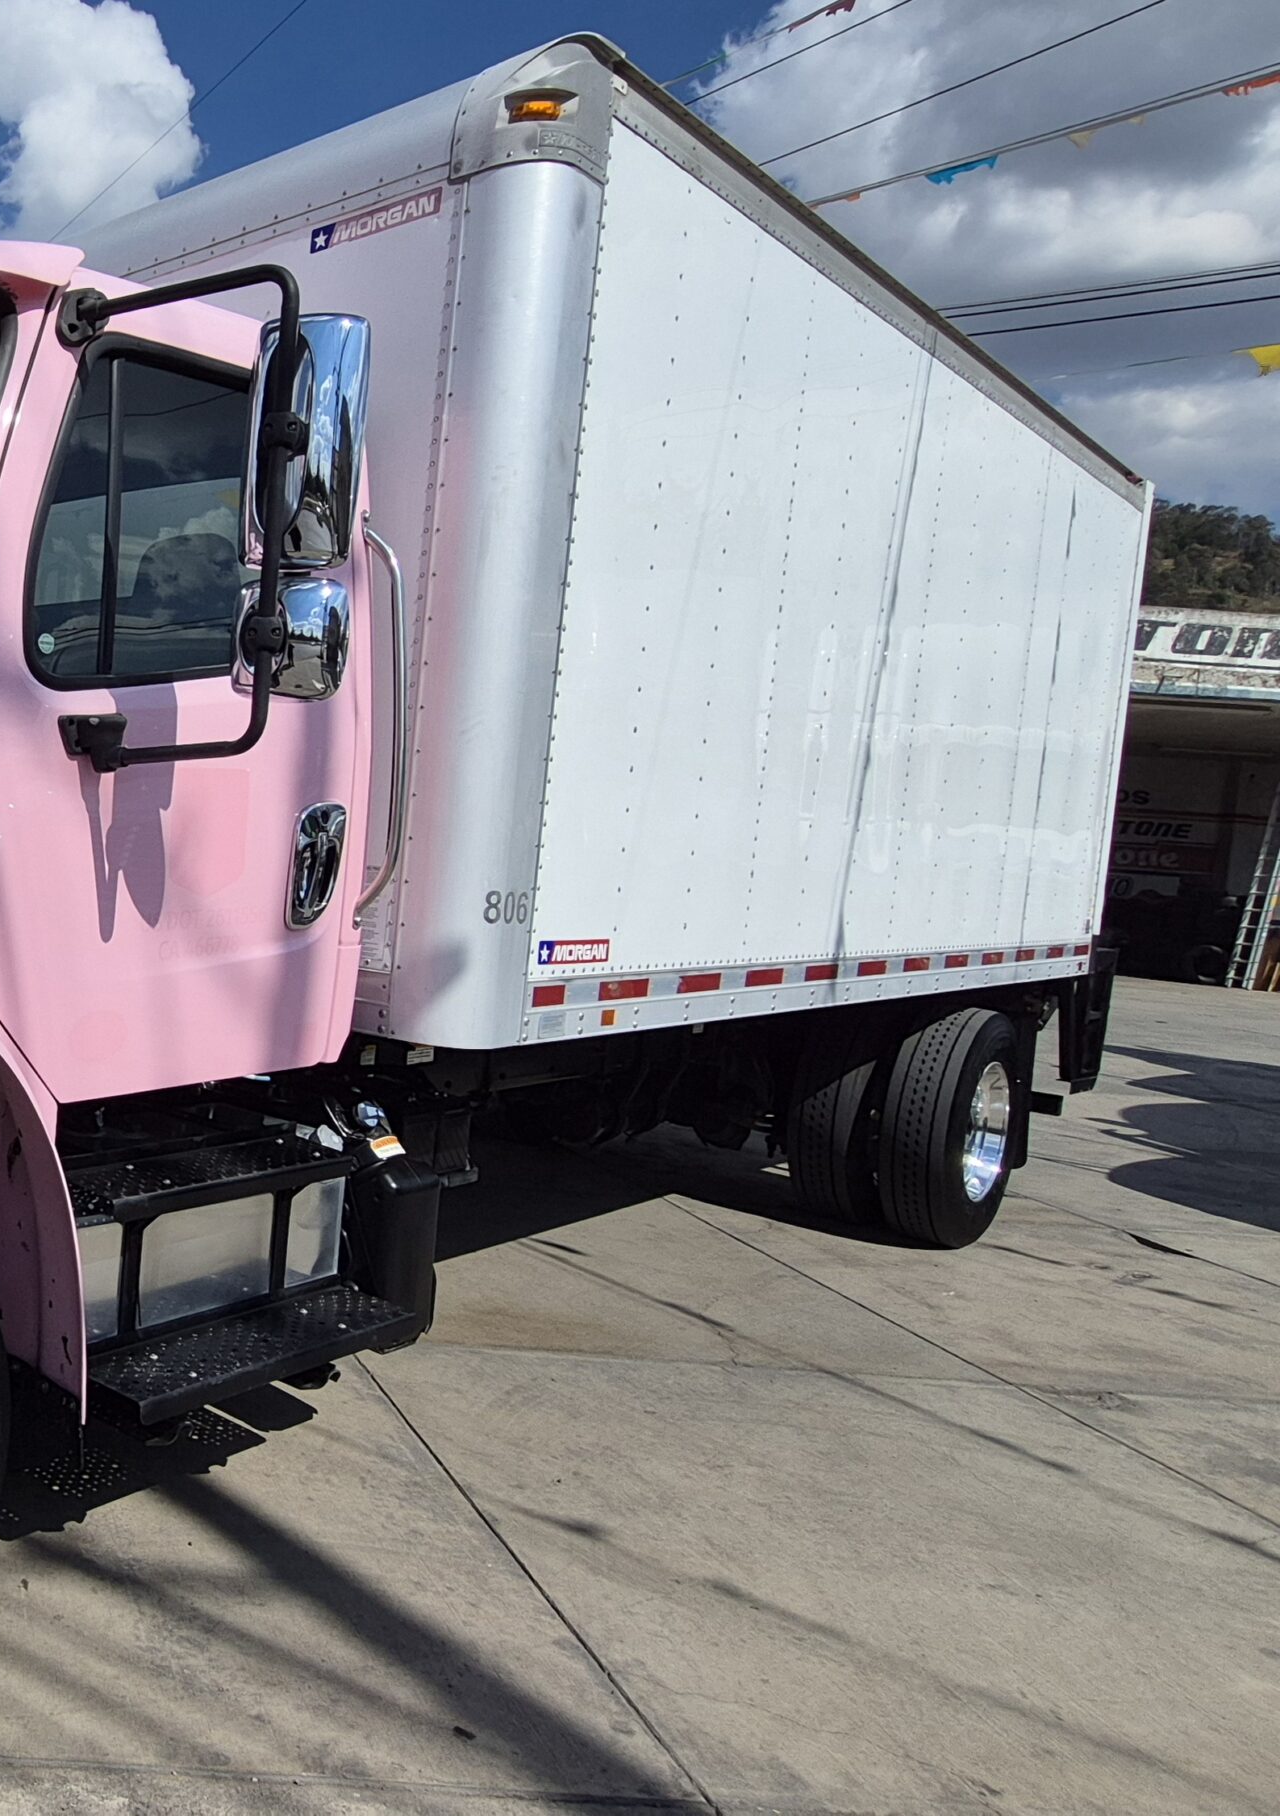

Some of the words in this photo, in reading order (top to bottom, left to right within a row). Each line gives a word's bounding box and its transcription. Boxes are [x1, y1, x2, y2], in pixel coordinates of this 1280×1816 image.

[332, 192, 440, 244] MORGAN
[483, 890, 529, 925] 806
[551, 943, 609, 963] MORGAN
